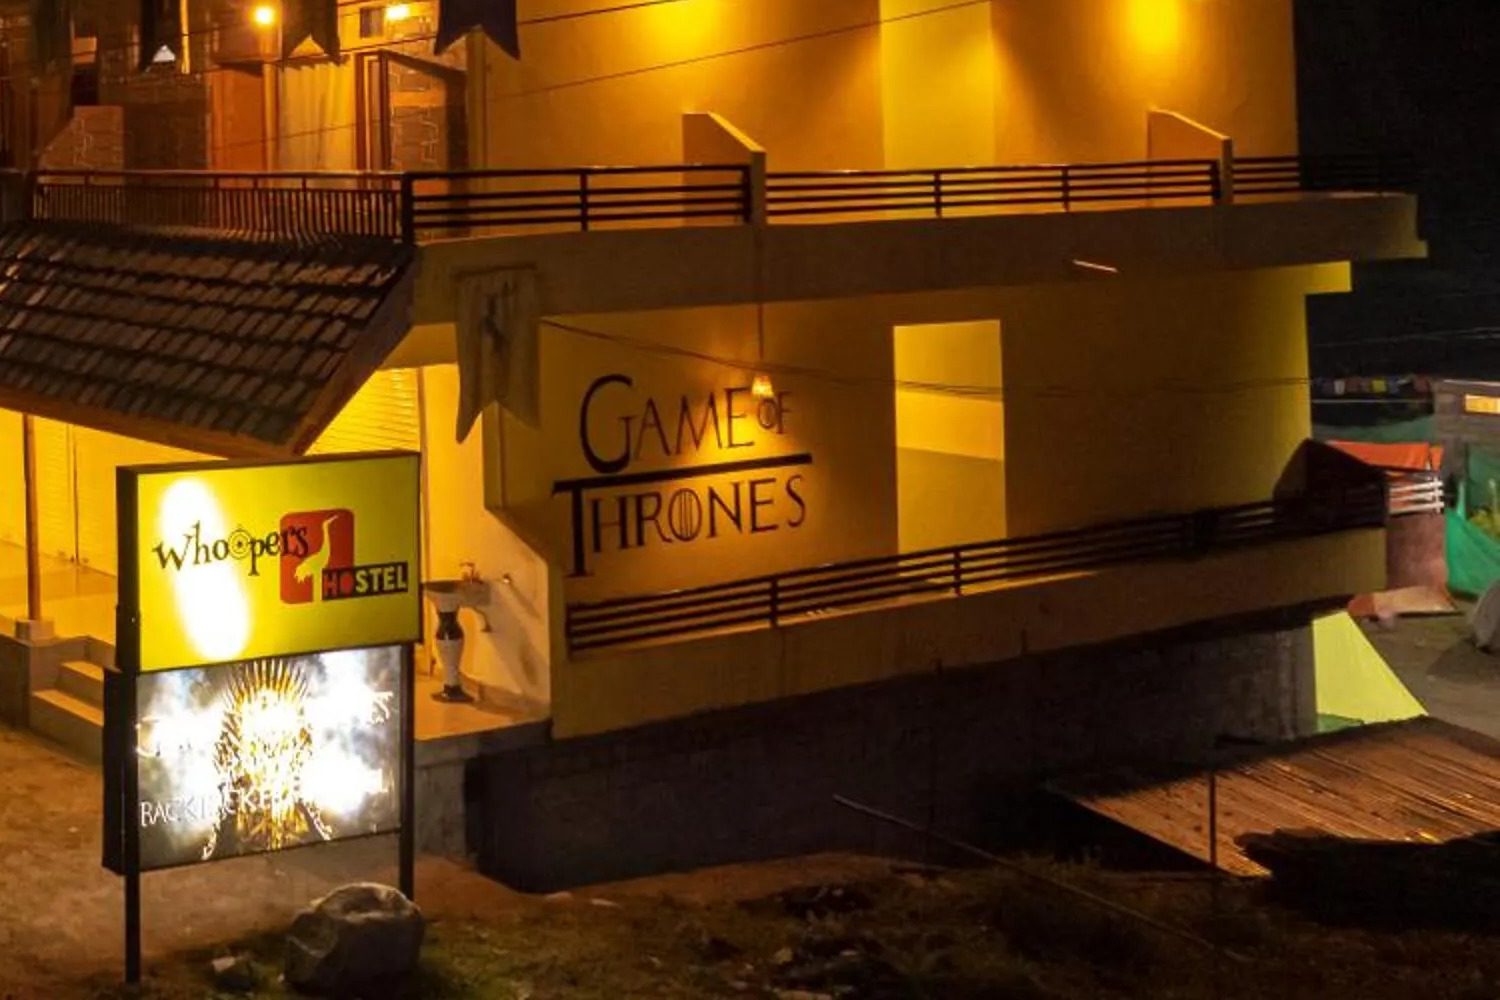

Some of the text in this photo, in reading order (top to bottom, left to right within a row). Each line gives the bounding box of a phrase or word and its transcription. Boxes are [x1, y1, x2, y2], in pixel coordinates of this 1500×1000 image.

[579, 374, 793, 473] GAME OF
[552, 455, 812, 578] THRONES
[323, 566, 407, 598] HOSTEL
